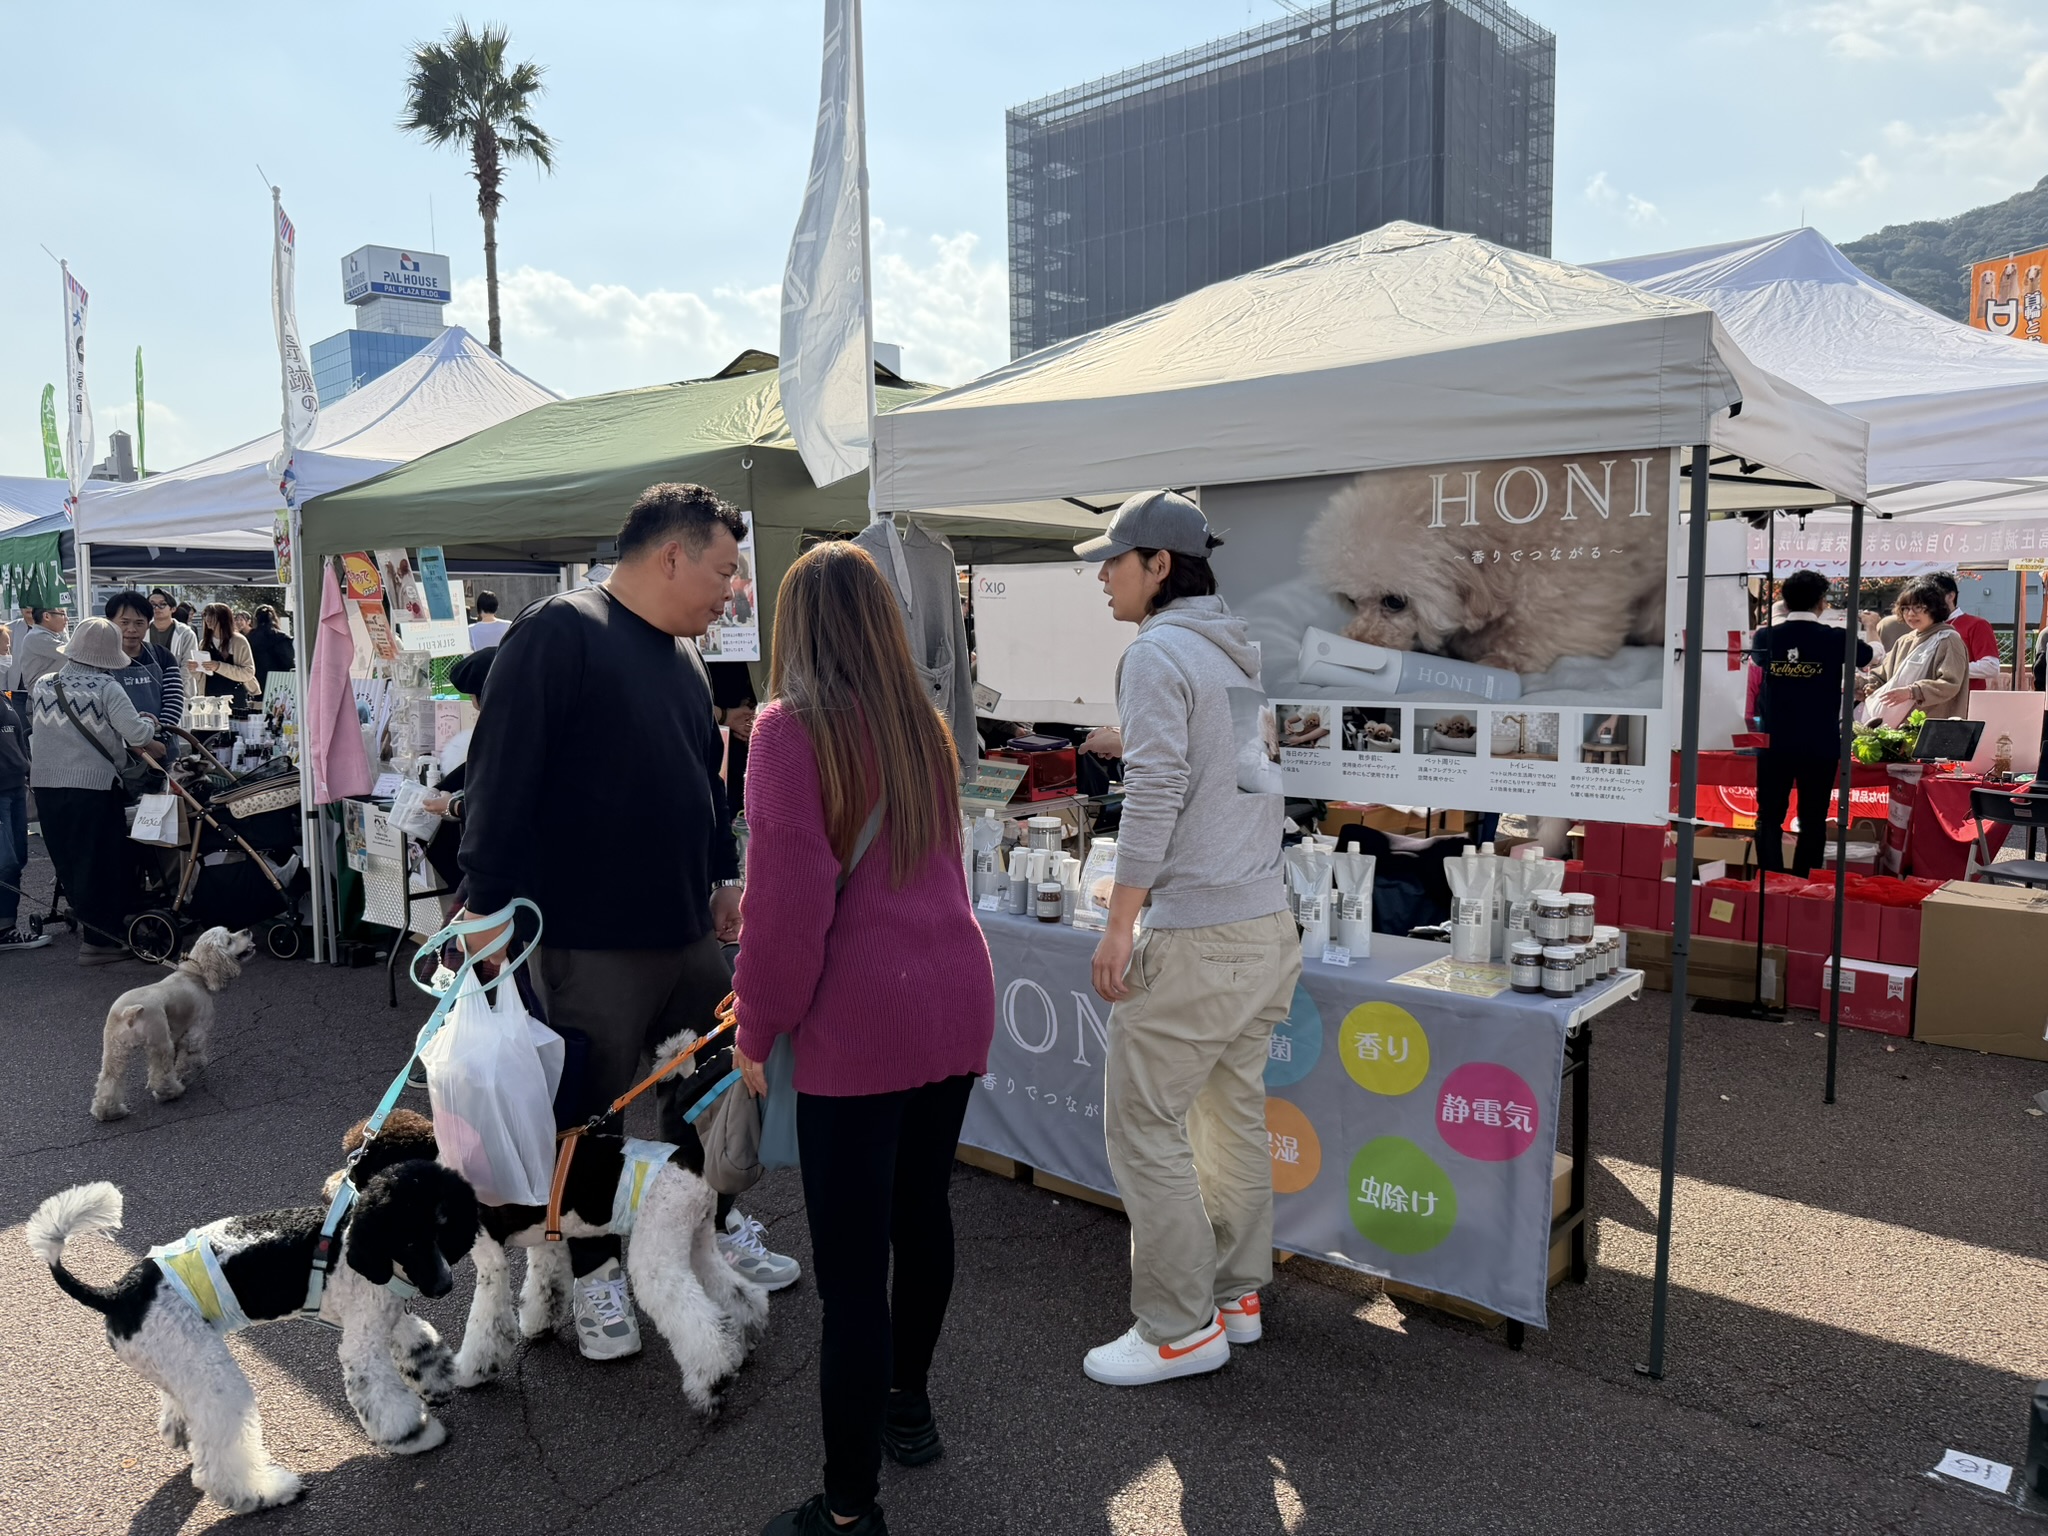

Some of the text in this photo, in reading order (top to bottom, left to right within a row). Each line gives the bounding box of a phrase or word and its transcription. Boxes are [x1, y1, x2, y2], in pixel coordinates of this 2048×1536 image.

[384, 271, 438, 288] PAL HOUSE
[398, 286, 420, 295] PLAZA
[1428, 457, 1653, 529] HONI
[1418, 667, 1472, 692] HONI
[1286, 750, 1320, 758] 毎日のケアに
[1584, 766, 1631, 775] 玄関やお車に
[1268, 1034, 1293, 1062] 菌
[1354, 1032, 1408, 1062] 香り
[1442, 1093, 1533, 1133] 静電気
[1357, 1176, 1439, 1217] 虫除け
